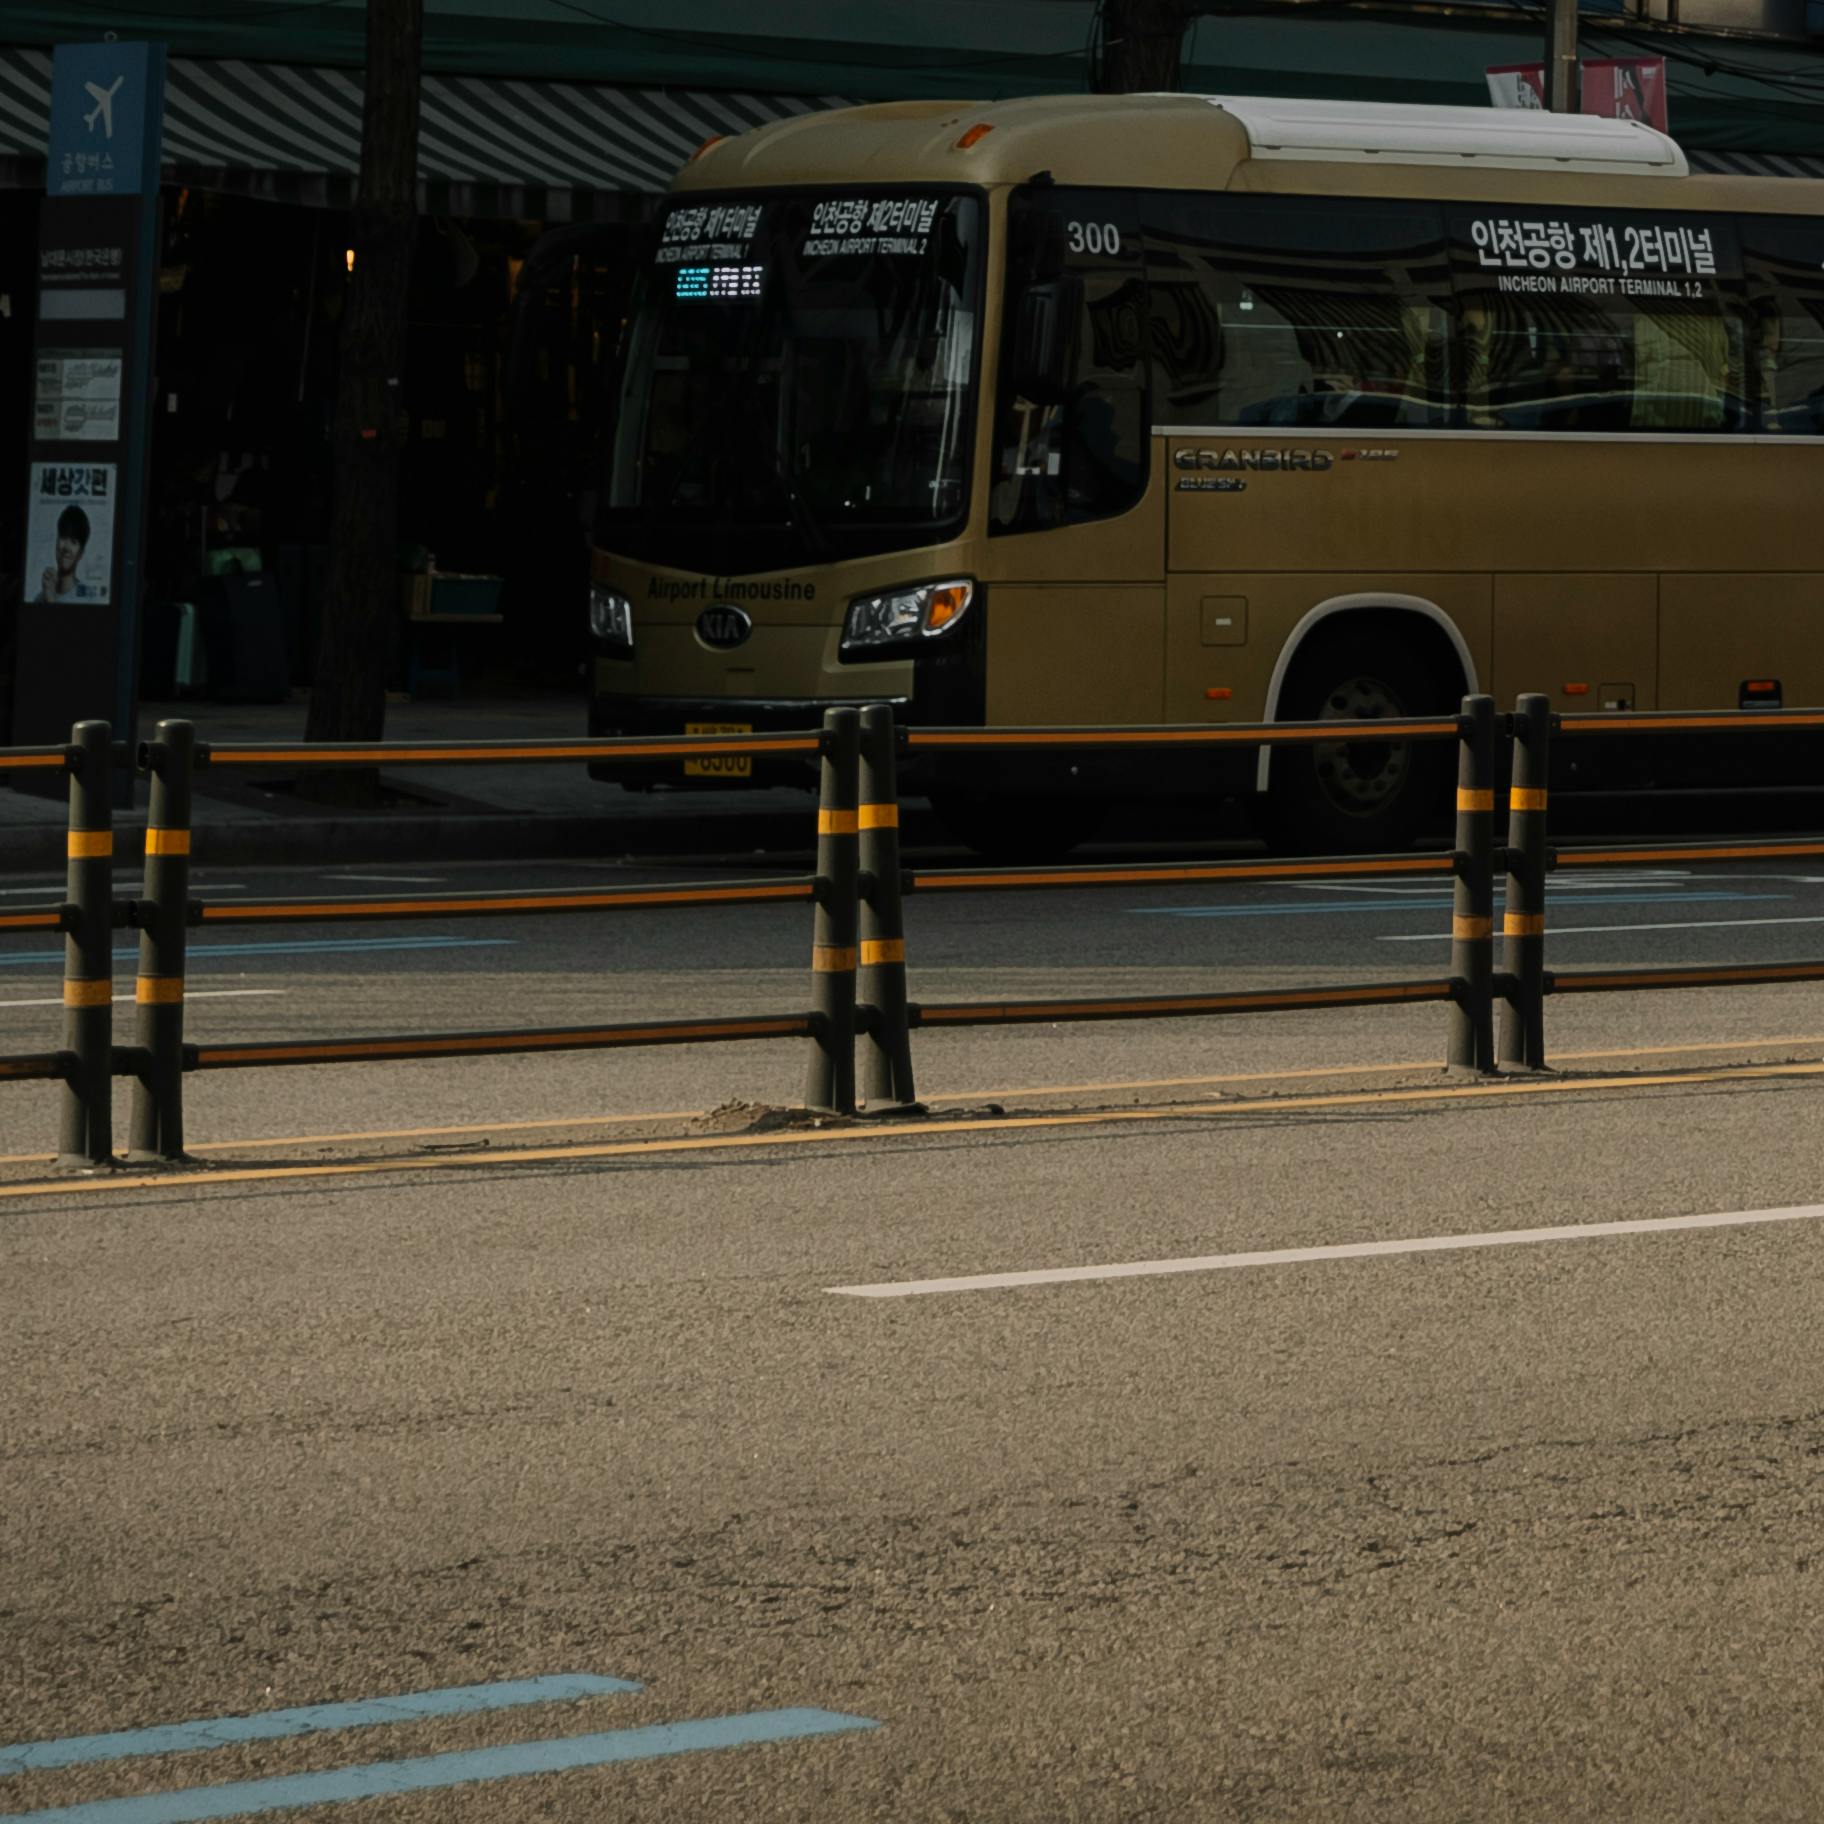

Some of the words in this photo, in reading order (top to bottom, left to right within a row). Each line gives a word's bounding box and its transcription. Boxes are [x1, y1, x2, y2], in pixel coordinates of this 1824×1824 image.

[662, 207, 708, 243] 인천공항
[704, 204, 763, 239] 제1터미널
[810, 200, 869, 235] 인천공항
[866, 199, 939, 234] 제2터미널
[802, 239, 838, 256] INCHEON
[837, 238, 875, 255] AIRPORT
[876, 238, 917, 255] TERMINAL
[1067, 221, 1121, 255] 300
[1471, 219, 1577, 269] 인천공항
[1578, 223, 1717, 276] 제1,2터미널
[1499, 275, 1557, 293] INCHEON
[1560, 277, 1615, 295] AIRPORT
[1618, 278, 1682, 297] TERMINAL
[1684, 281, 1703, 298] 1,2
[1175, 449, 1334, 471] GRANBIRD
[648, 577, 706, 603] Airport
[713, 577, 815, 600] Limousine
[702, 612, 740, 640] KIA
